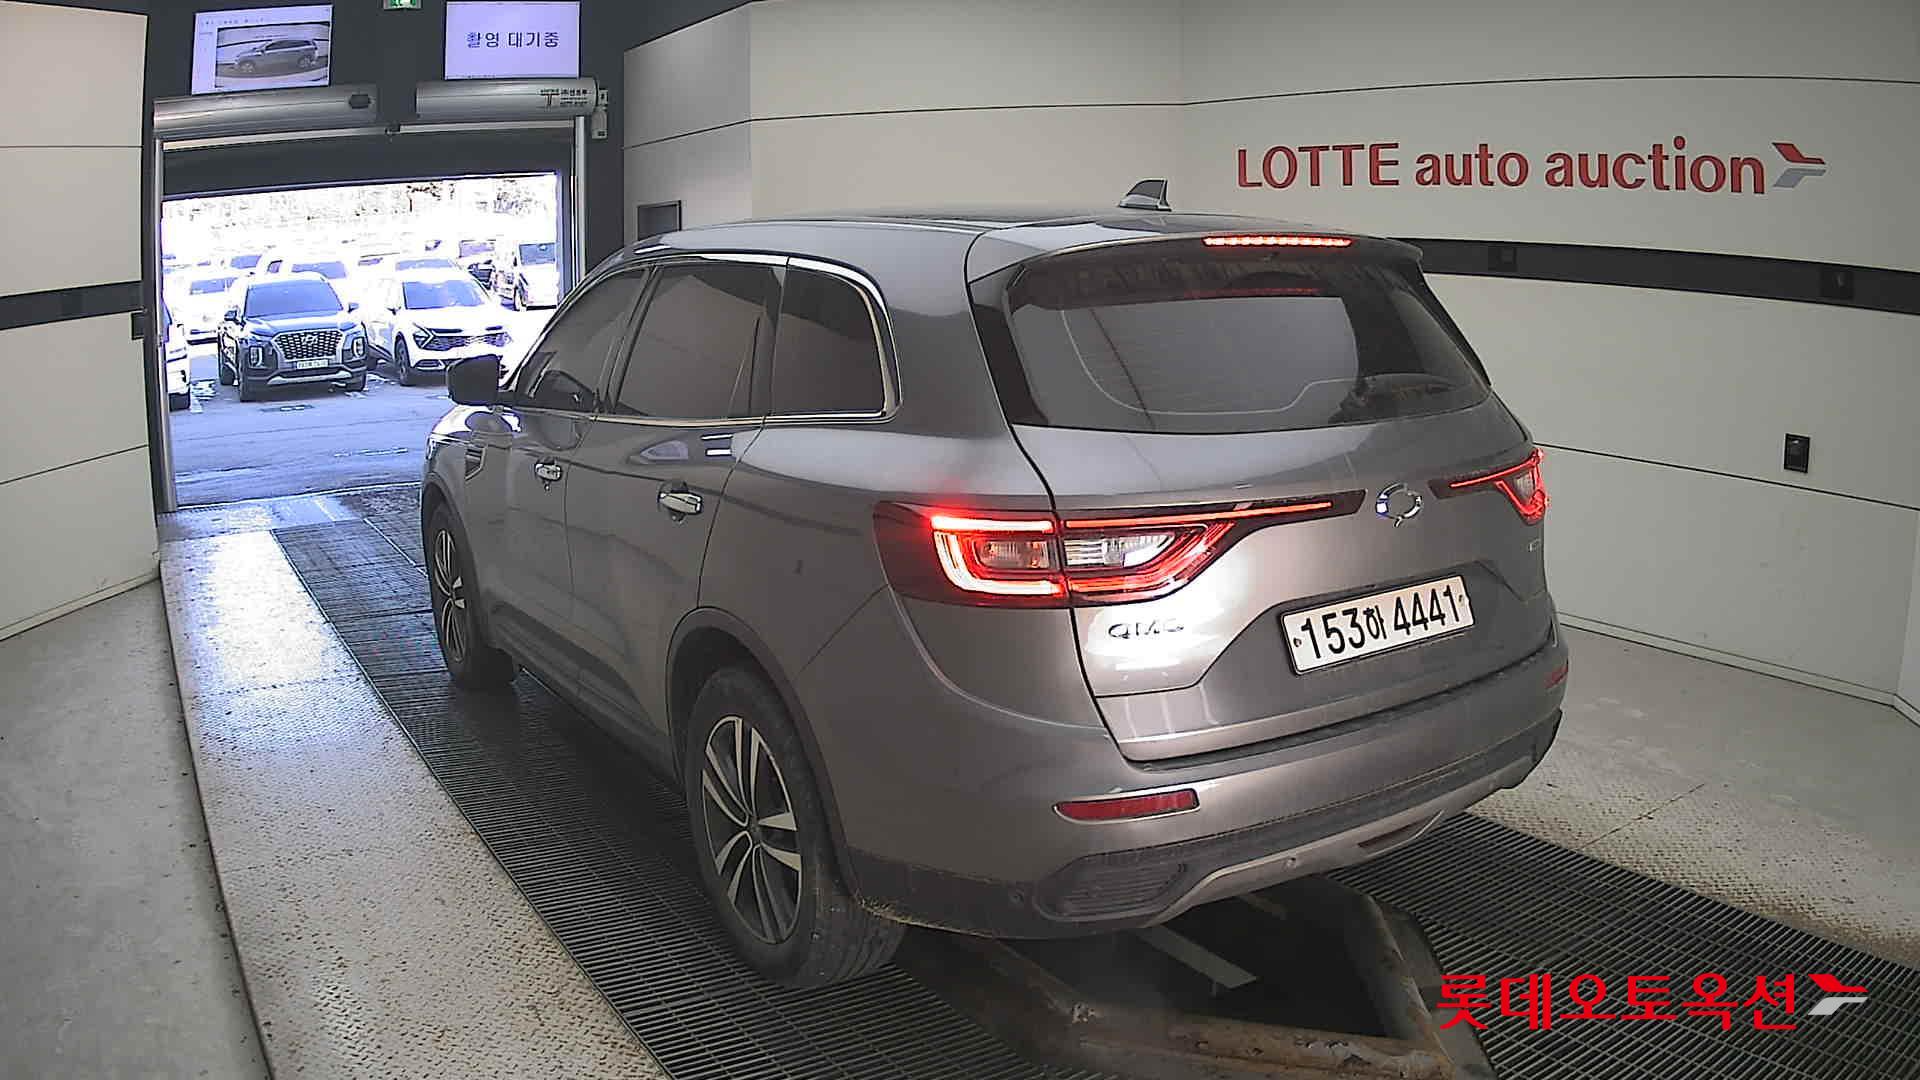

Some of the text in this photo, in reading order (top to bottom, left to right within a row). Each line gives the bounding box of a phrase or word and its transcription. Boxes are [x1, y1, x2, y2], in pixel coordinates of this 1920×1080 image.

[467, 32, 560, 48] 촬영 대기중
[1237, 136, 1766, 194] LOTTE auto auction
[1301, 584, 1460, 659] 153하 4441
